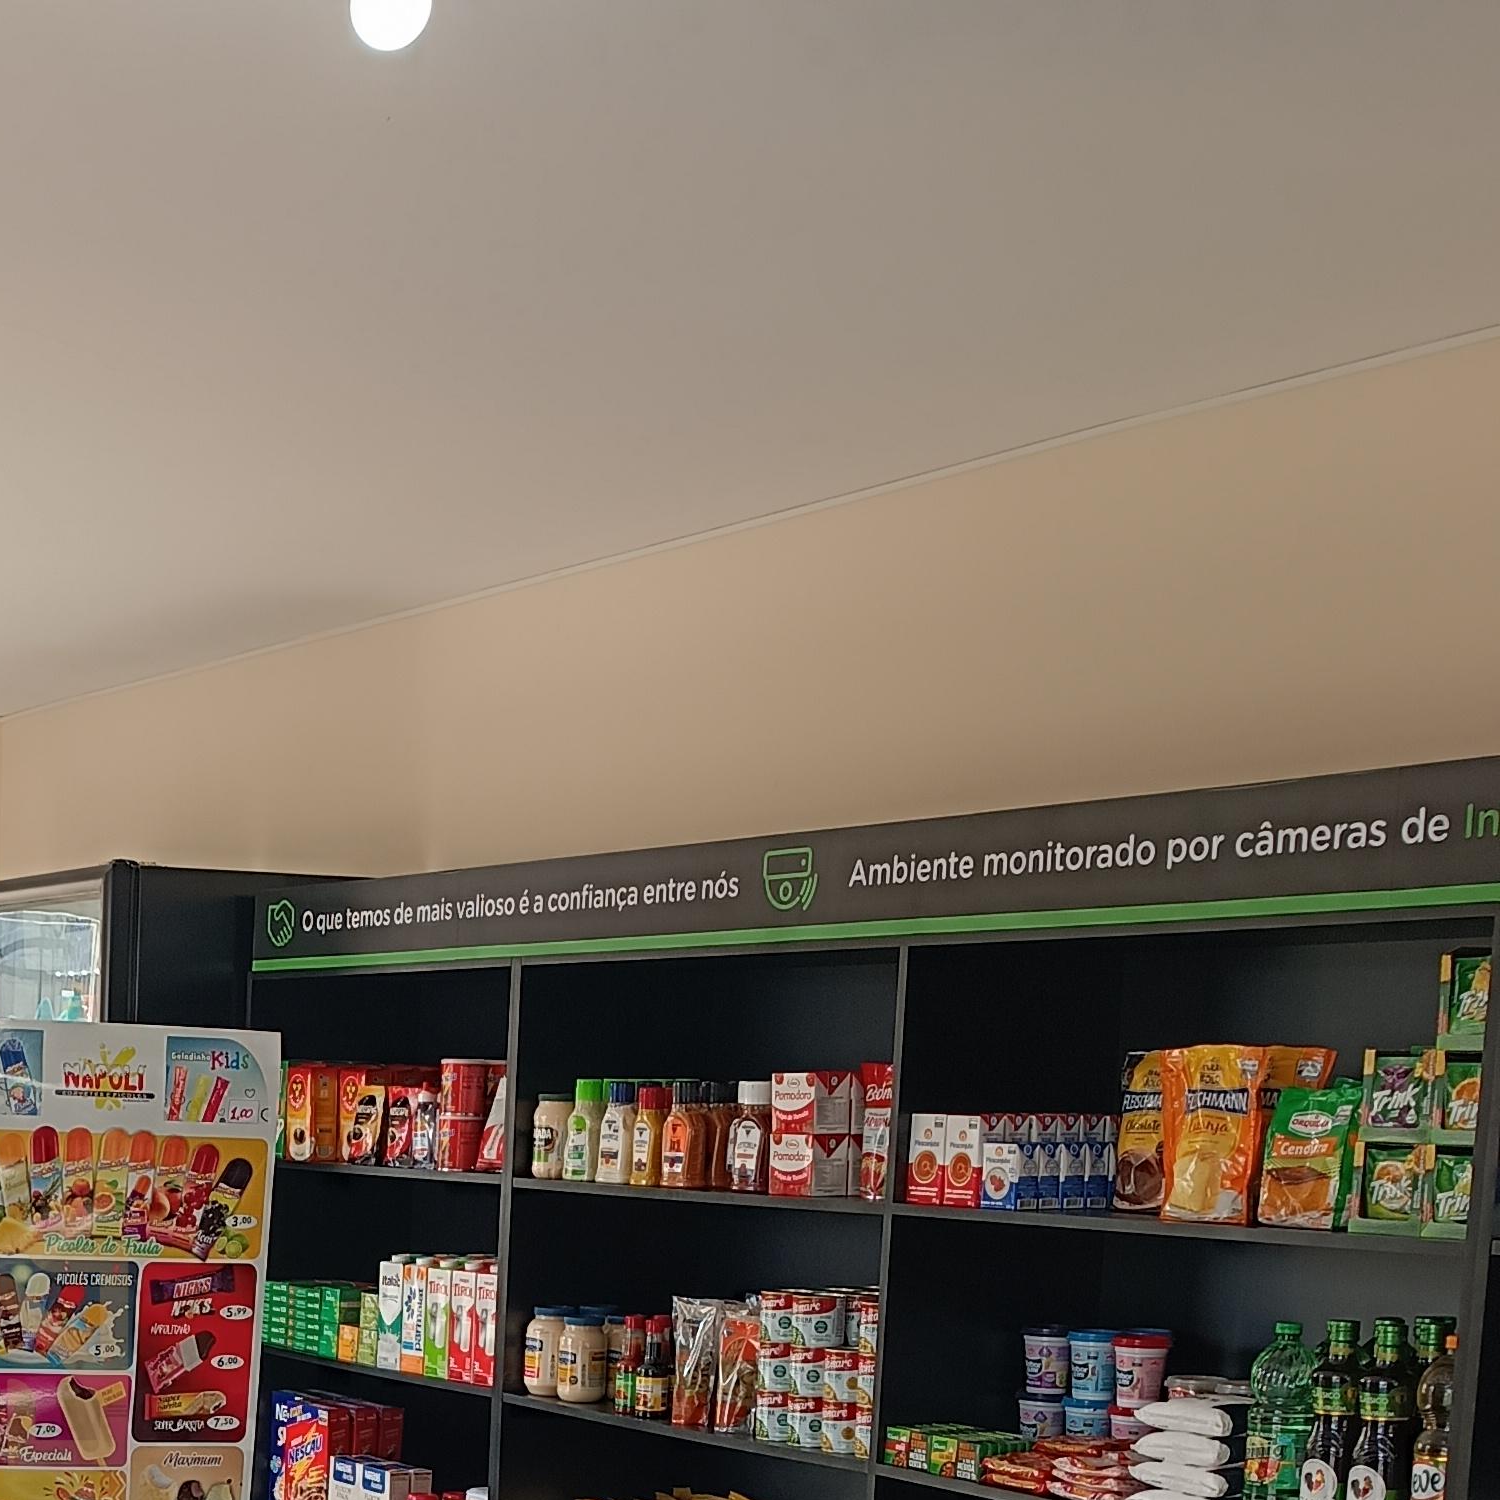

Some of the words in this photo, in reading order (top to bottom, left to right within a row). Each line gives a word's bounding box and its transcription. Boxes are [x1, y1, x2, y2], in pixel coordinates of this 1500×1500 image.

[847, 851, 975, 888] Ambiente
[982, 834, 1156, 877] monitorado
[1166, 830, 1224, 870] por
[1234, 821, 1387, 858] câmeras
[1401, 807, 1451, 843] de
[301, 909, 314, 932] O
[316, 911, 343, 935] que
[345, 906, 391, 930] temos
[393, 903, 413, 925] de
[416, 899, 453, 923] mais
[456, 892, 516, 919] valioso
[517, 889, 530, 914] é
[533, 895, 544, 913] a
[547, 883, 638, 914] confiança
[643, 882, 696, 906] entre
[701, 872, 739, 898] nós
[211, 1051, 250, 1070] Kids
[63, 1062, 147, 1091] NAPOLI
[775, 1089, 811, 1100] Pomodoro
[773, 1151, 810, 1160] Pomodoro
[45, 1233, 98, 1254] Picolés
[101, 1238, 117, 1254] de
[121, 1236, 163, 1256] Fruta
[56, 1272, 89, 1286] PICOLÉS
[90, 1274, 133, 1286] CREMOSOS
[164, 1452, 223, 1467] Maximum
[288, 1435, 323, 1466] NESCAU
